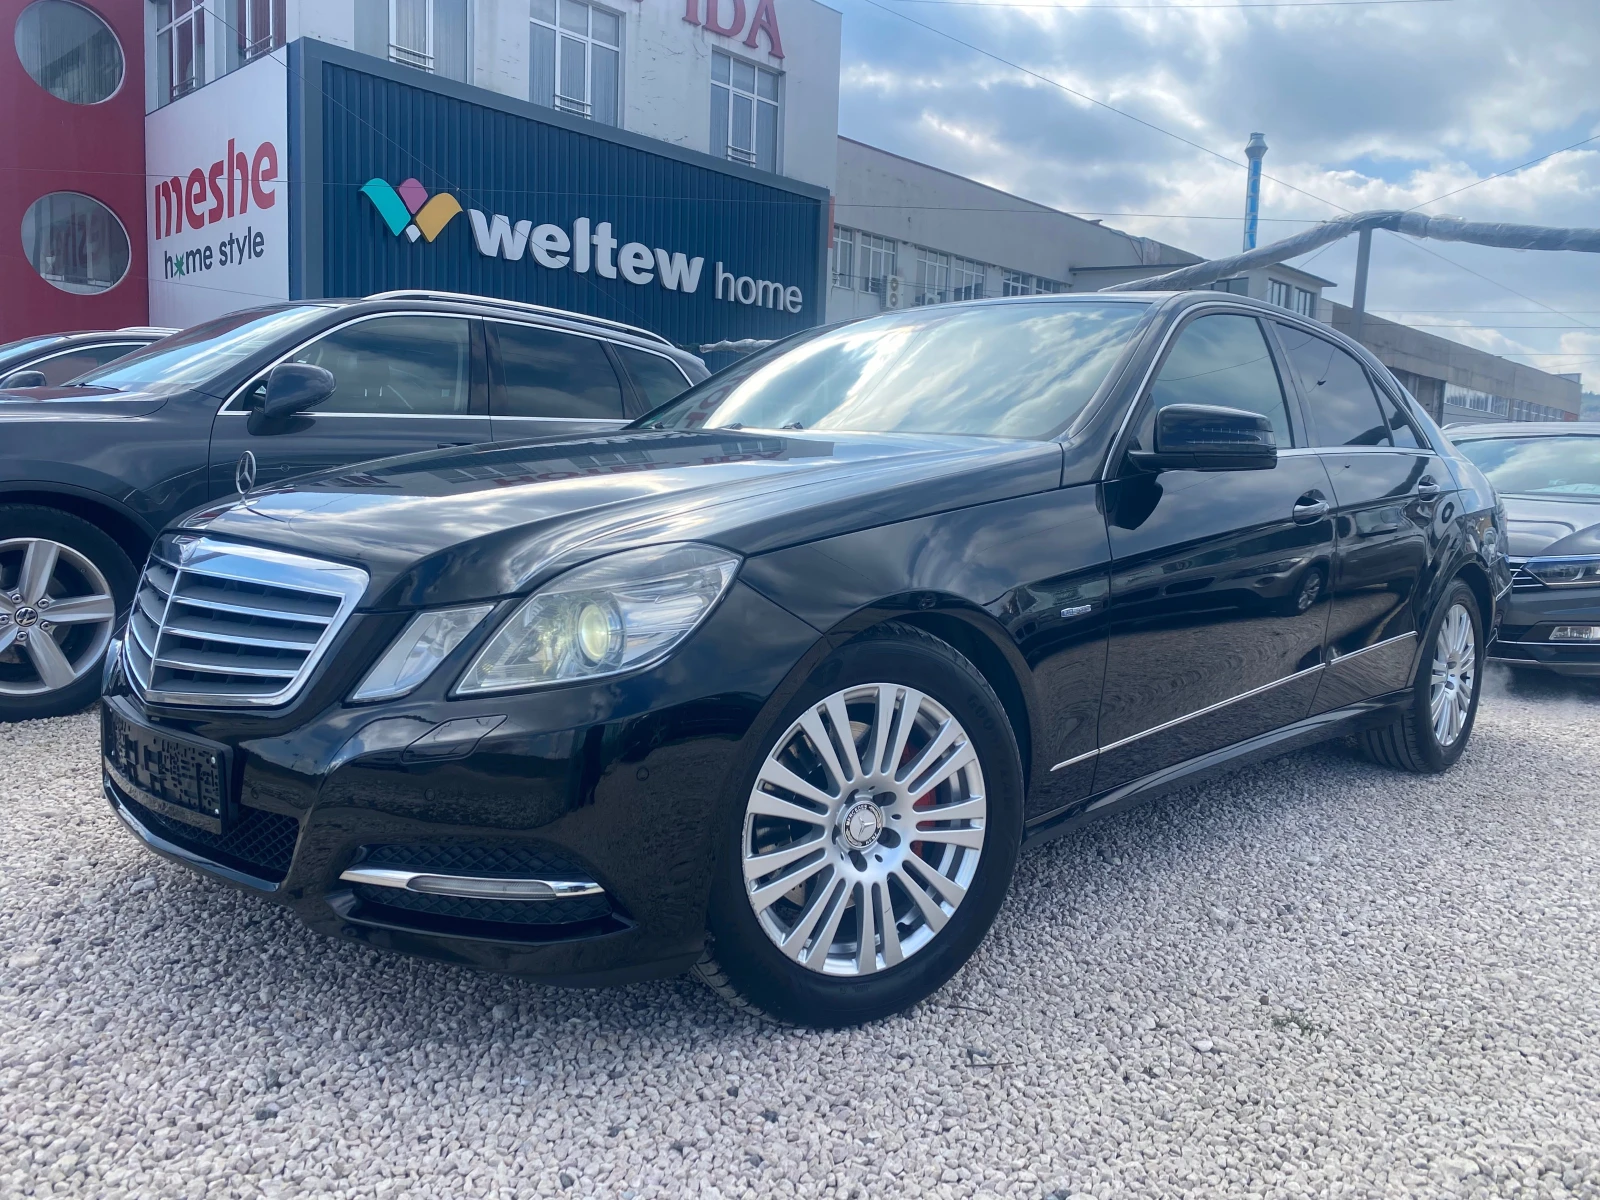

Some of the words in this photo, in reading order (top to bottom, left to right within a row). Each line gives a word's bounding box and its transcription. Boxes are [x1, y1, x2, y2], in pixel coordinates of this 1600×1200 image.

[155, 138, 278, 240] meshe
[218, 226, 265, 266] style
[467, 208, 704, 294] weltew
[715, 261, 803, 314] home
